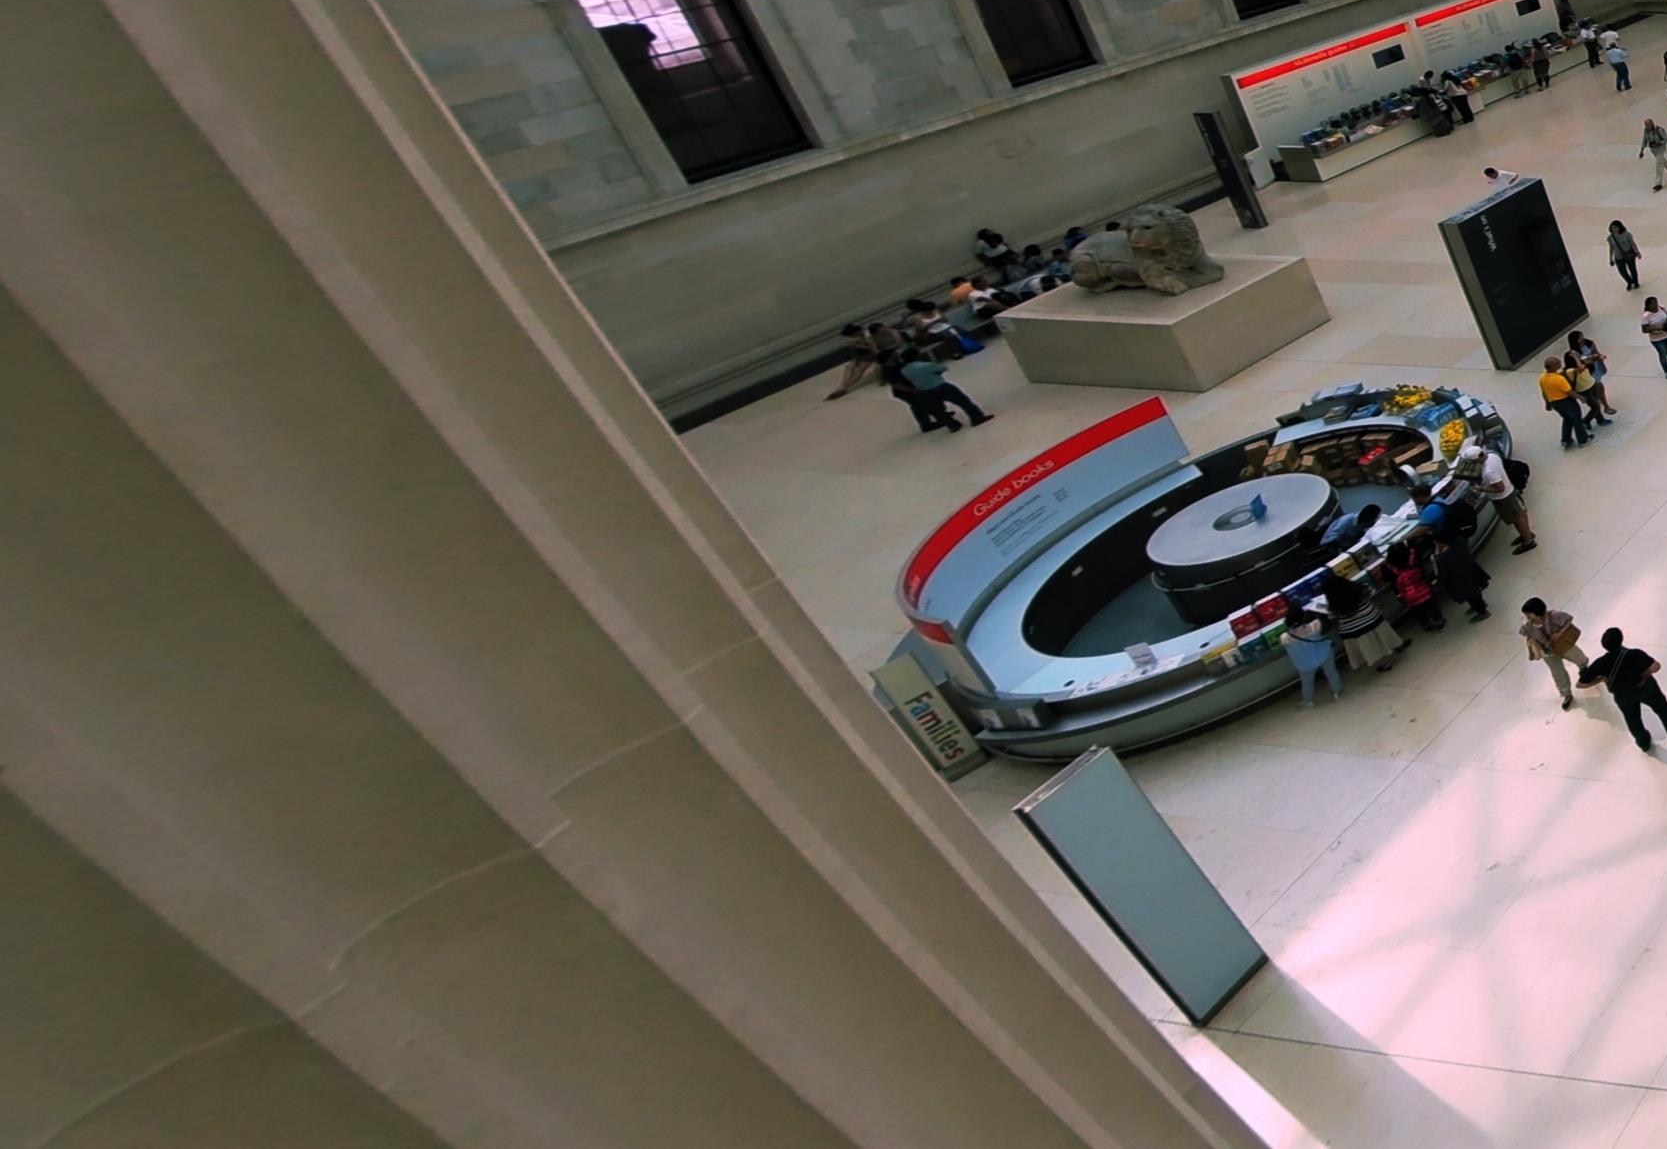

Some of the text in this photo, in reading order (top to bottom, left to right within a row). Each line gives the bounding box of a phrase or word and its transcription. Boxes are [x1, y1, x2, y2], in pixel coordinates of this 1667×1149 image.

[973, 459, 1055, 517] Guide books
[904, 691, 966, 761] Families
